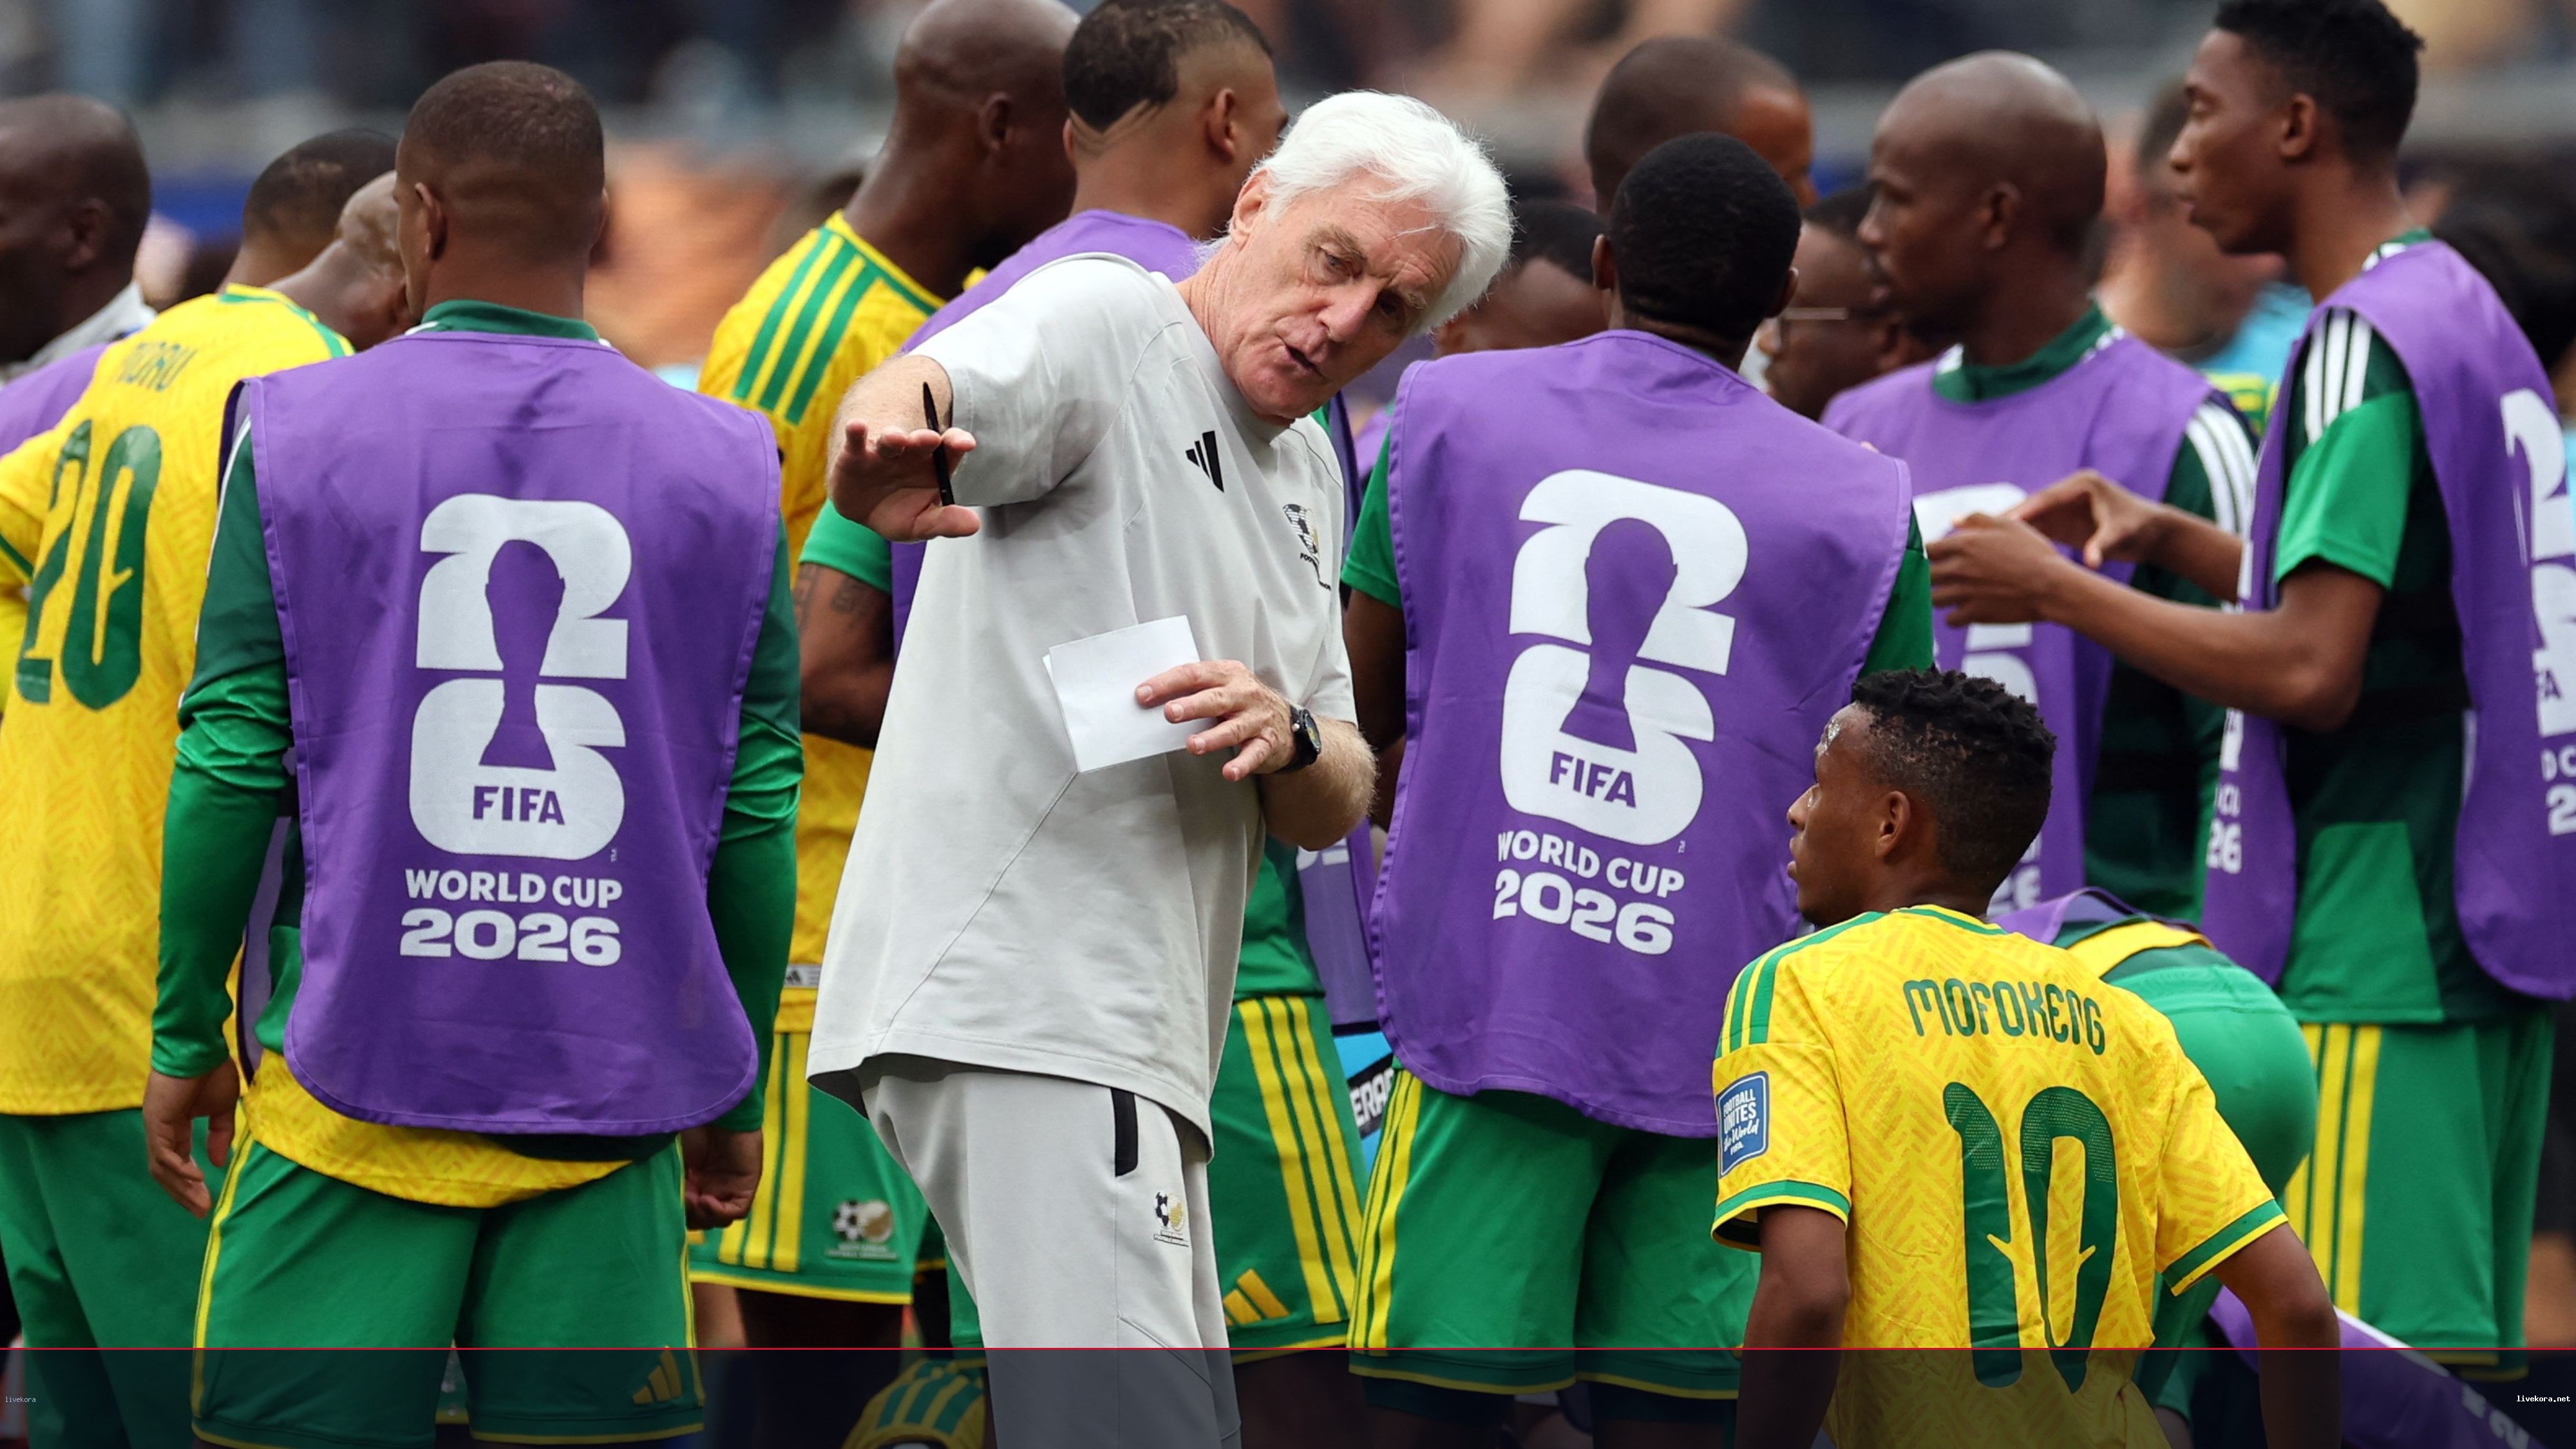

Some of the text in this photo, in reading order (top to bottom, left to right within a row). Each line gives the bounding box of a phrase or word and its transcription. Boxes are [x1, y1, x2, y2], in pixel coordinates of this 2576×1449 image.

[15, 419, 162, 712] 20
[473, 785, 565, 826] FIFA
[1549, 750, 1636, 809] FIFA
[1497, 829, 1685, 898] WORLD CUP
[2205, 817, 2242, 875] 26
[405, 869, 623, 909] WORLD CUP
[1492, 868, 1675, 955] 2026
[399, 907, 621, 967] 2026
[1902, 978, 2106, 1056] MOFOKENG
[1723, 1088, 1756, 1118] FOOTBALL
[1723, 1101, 1757, 1135] UNITES
[1731, 1118, 1760, 1144] World
[1942, 1081, 2118, 1395] 10
